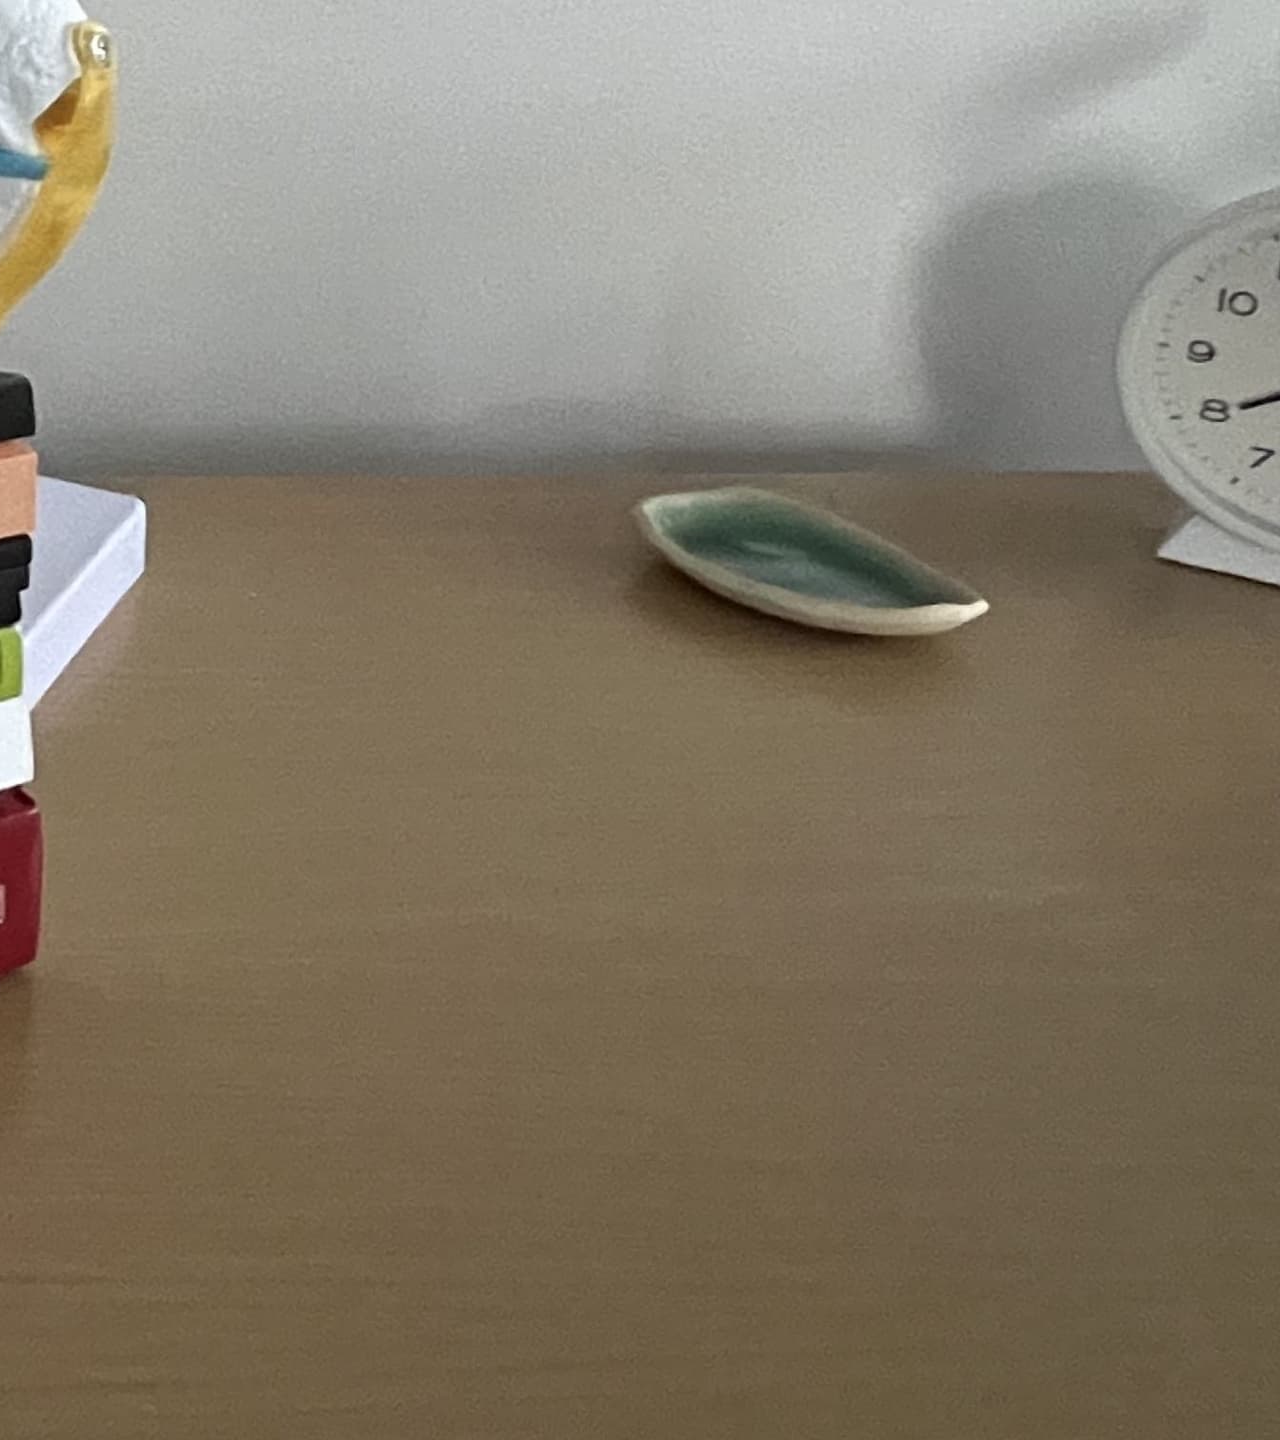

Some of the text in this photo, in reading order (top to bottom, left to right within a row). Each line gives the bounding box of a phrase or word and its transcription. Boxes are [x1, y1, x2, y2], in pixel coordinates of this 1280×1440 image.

[1217, 287, 1258, 317] 10
[1187, 339, 1216, 363] 9
[1200, 398, 1230, 422] 8
[1249, 446, 1276, 468] 7
